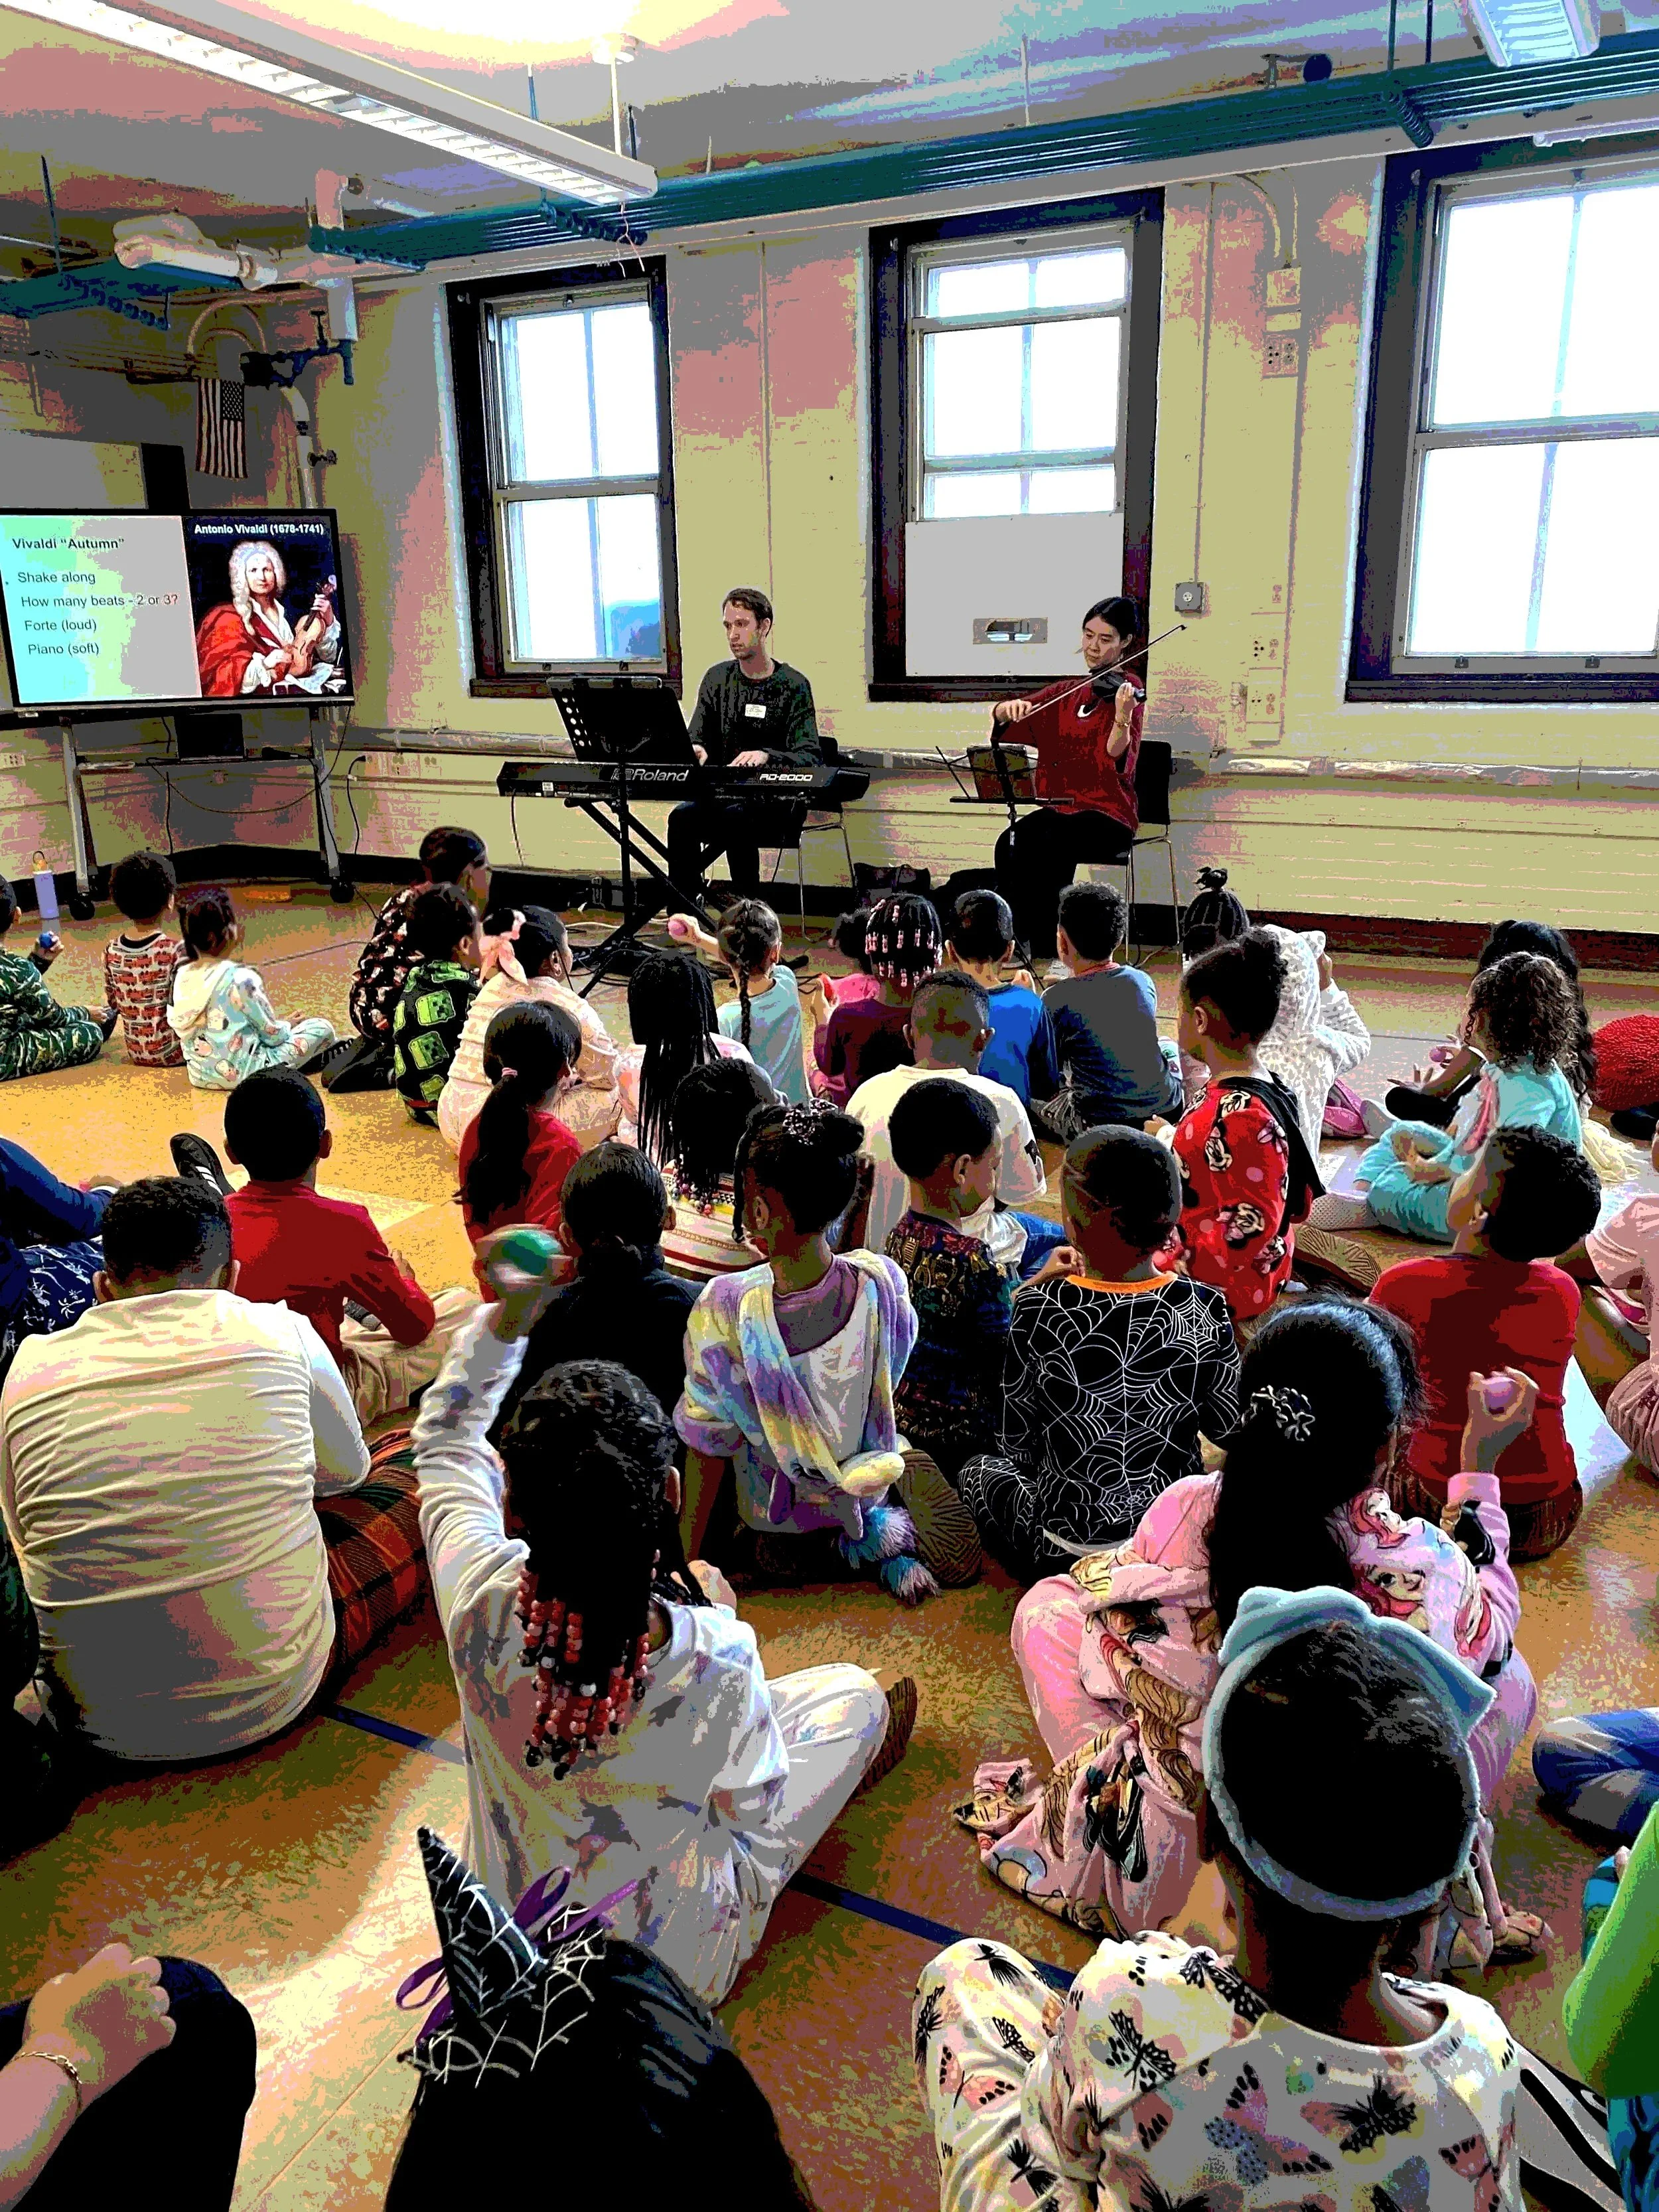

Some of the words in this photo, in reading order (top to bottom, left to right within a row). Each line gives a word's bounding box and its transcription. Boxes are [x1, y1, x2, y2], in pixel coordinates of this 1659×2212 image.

[194, 524, 233, 534] Antonio
[234, 524, 267, 534] Vivaldi
[270, 524, 323, 536] (1678-1741)
[12, 538, 56, 549] Vivaldi
[17, 572, 57, 583] Shake
[62, 571, 96, 585] along
[21, 596, 49, 607] How
[54, 597, 87, 609] many
[92, 595, 125, 606] beats
[137, 595, 145, 605] 2
[147, 597, 160, 605] or
[164, 595, 178, 605] 3?
[25, 620, 57, 630] Forte
[62, 619, 97, 633] (loud)
[28, 644, 64, 655] Piano
[68, 642, 100, 657] (soft)
[632, 769, 689, 782] Roland
